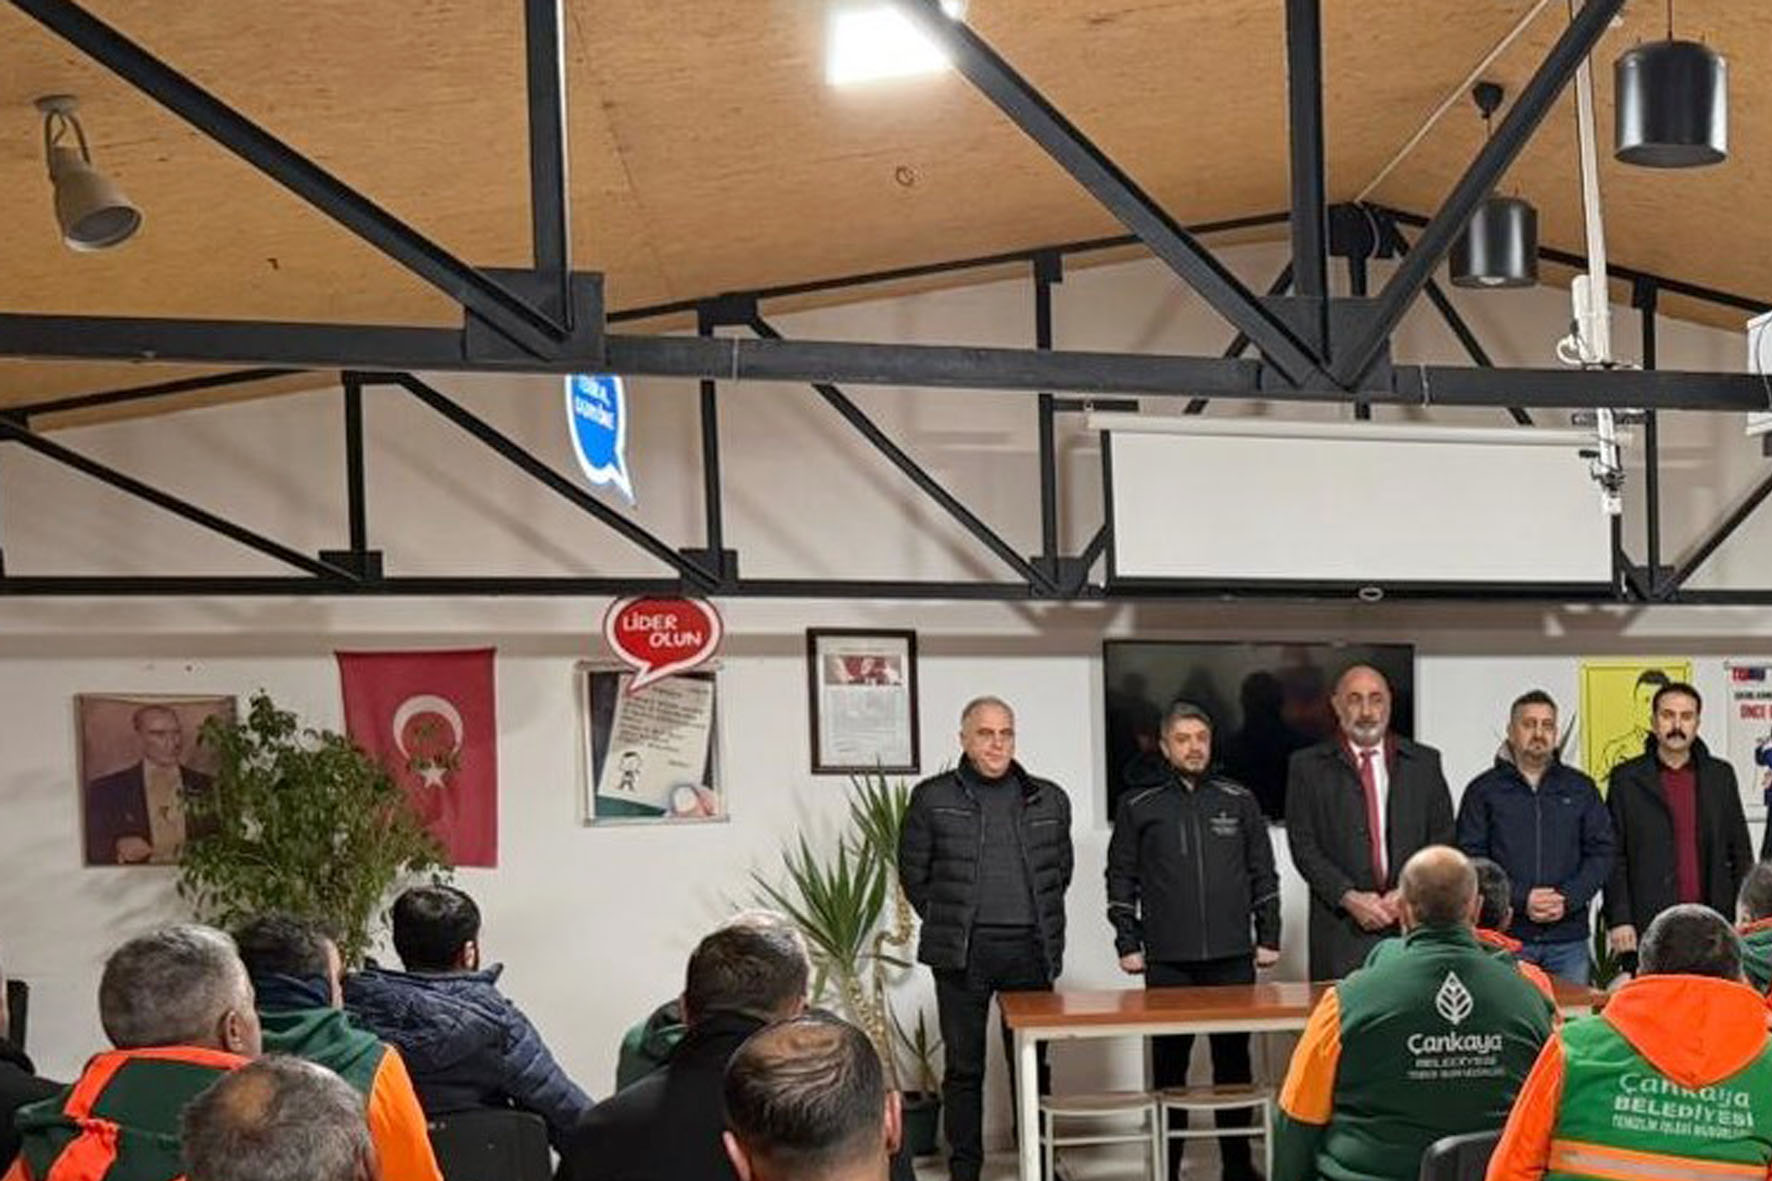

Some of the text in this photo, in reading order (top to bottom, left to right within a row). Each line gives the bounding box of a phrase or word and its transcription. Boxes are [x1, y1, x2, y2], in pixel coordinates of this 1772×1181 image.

[623, 611, 678, 632] LİDER
[649, 630, 702, 648] OLUN
[1407, 1031, 1502, 1055] Çankaya
